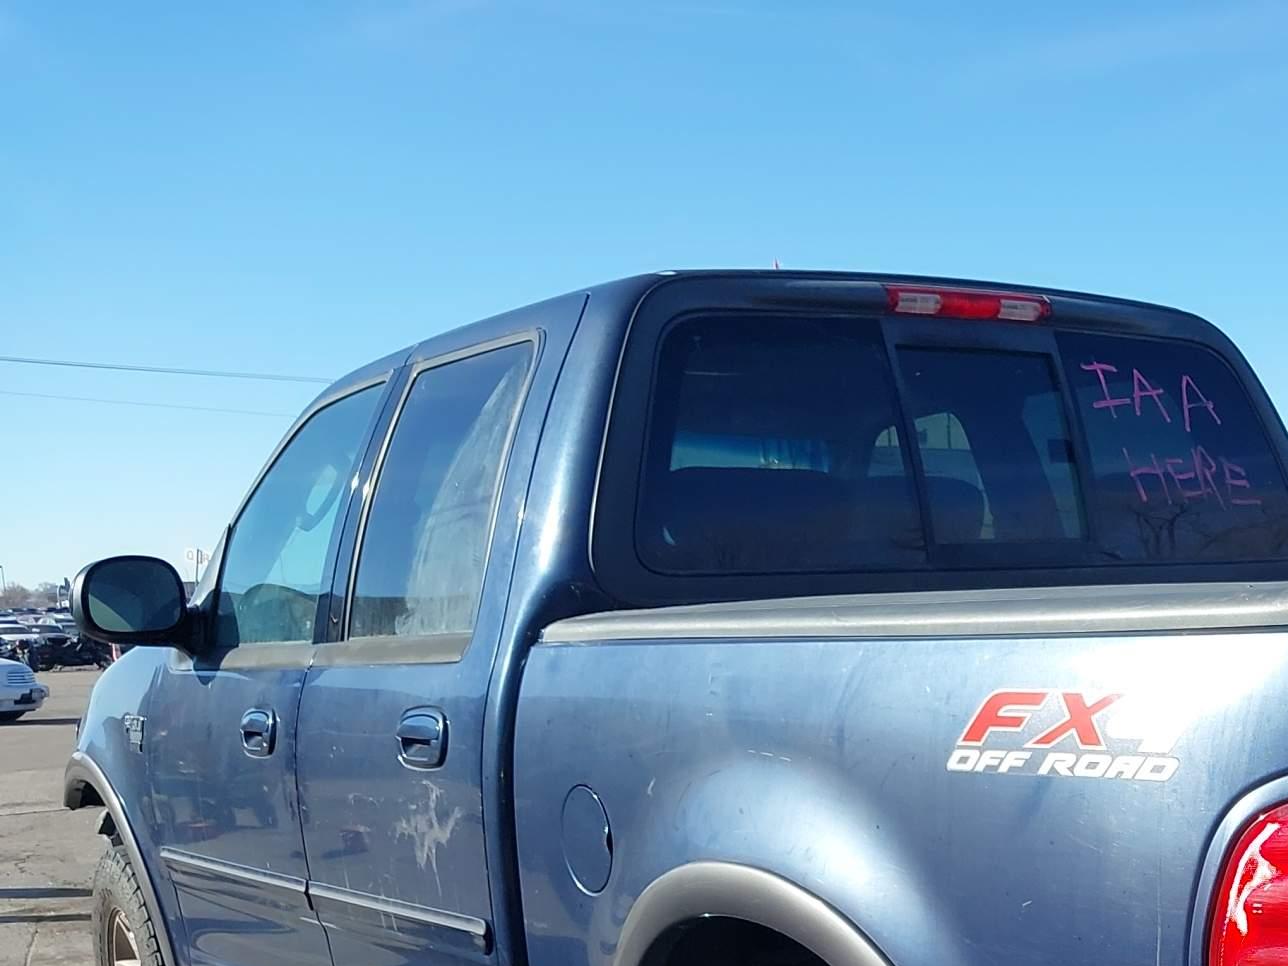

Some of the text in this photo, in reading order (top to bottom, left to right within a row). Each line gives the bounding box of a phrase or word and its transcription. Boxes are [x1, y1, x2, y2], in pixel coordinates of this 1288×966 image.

[1079, 360, 1223, 433] IAA
[1121, 445, 1263, 512] HERE
[946, 749, 1181, 782] OFF ROAD
